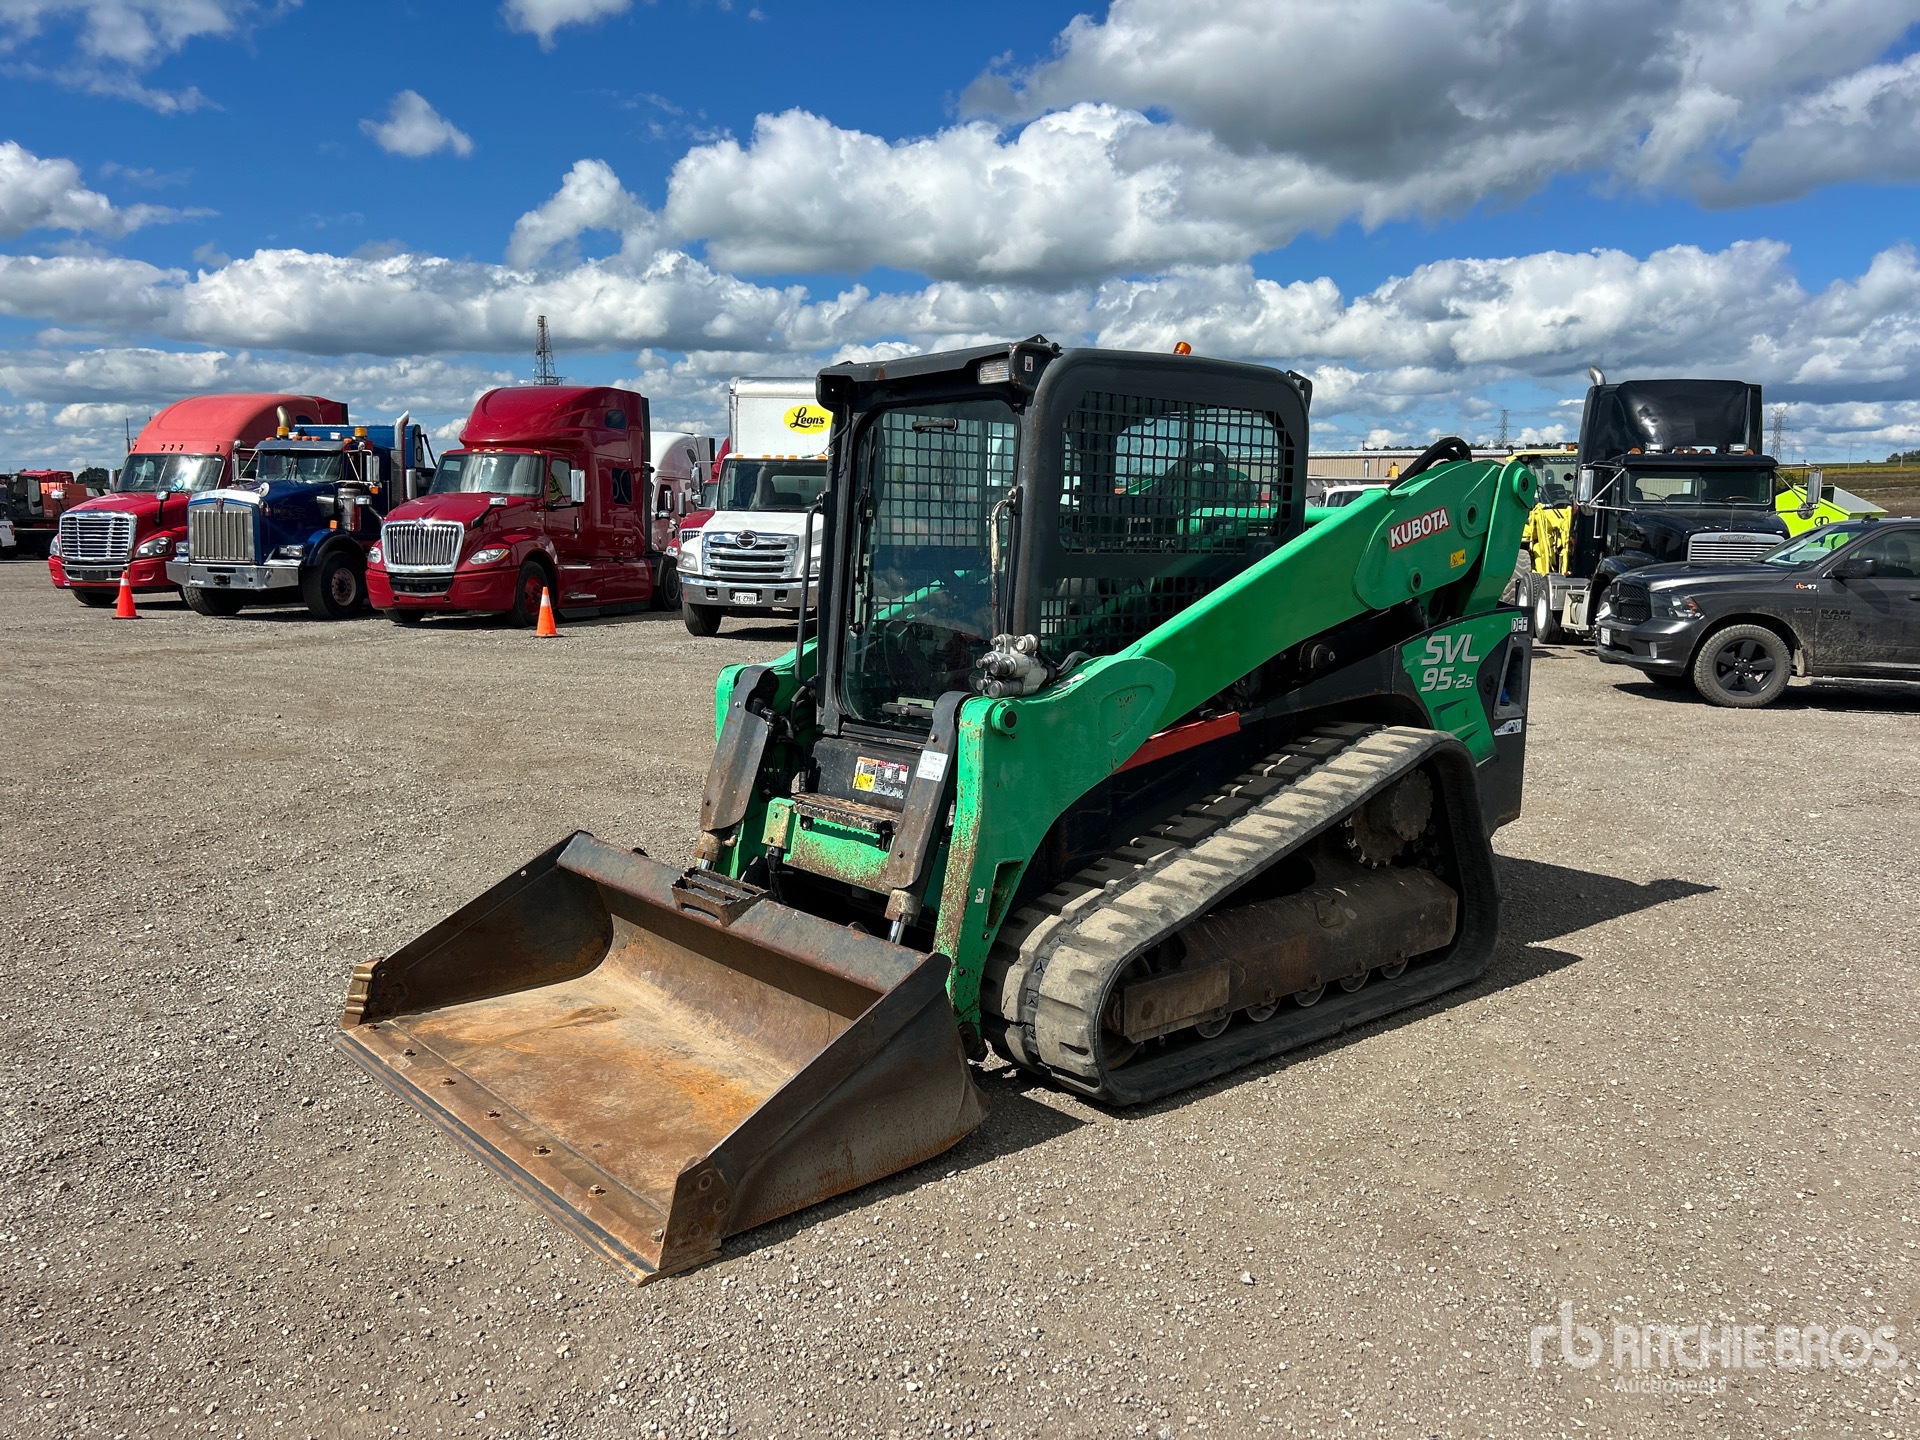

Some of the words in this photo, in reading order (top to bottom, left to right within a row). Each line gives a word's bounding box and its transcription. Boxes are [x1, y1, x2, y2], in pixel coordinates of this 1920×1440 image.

[790, 406, 825, 428] Leon's
[1390, 508, 1449, 548] KUBOTA
[1511, 617, 1528, 632] DEF
[1420, 633, 1480, 666] SVL
